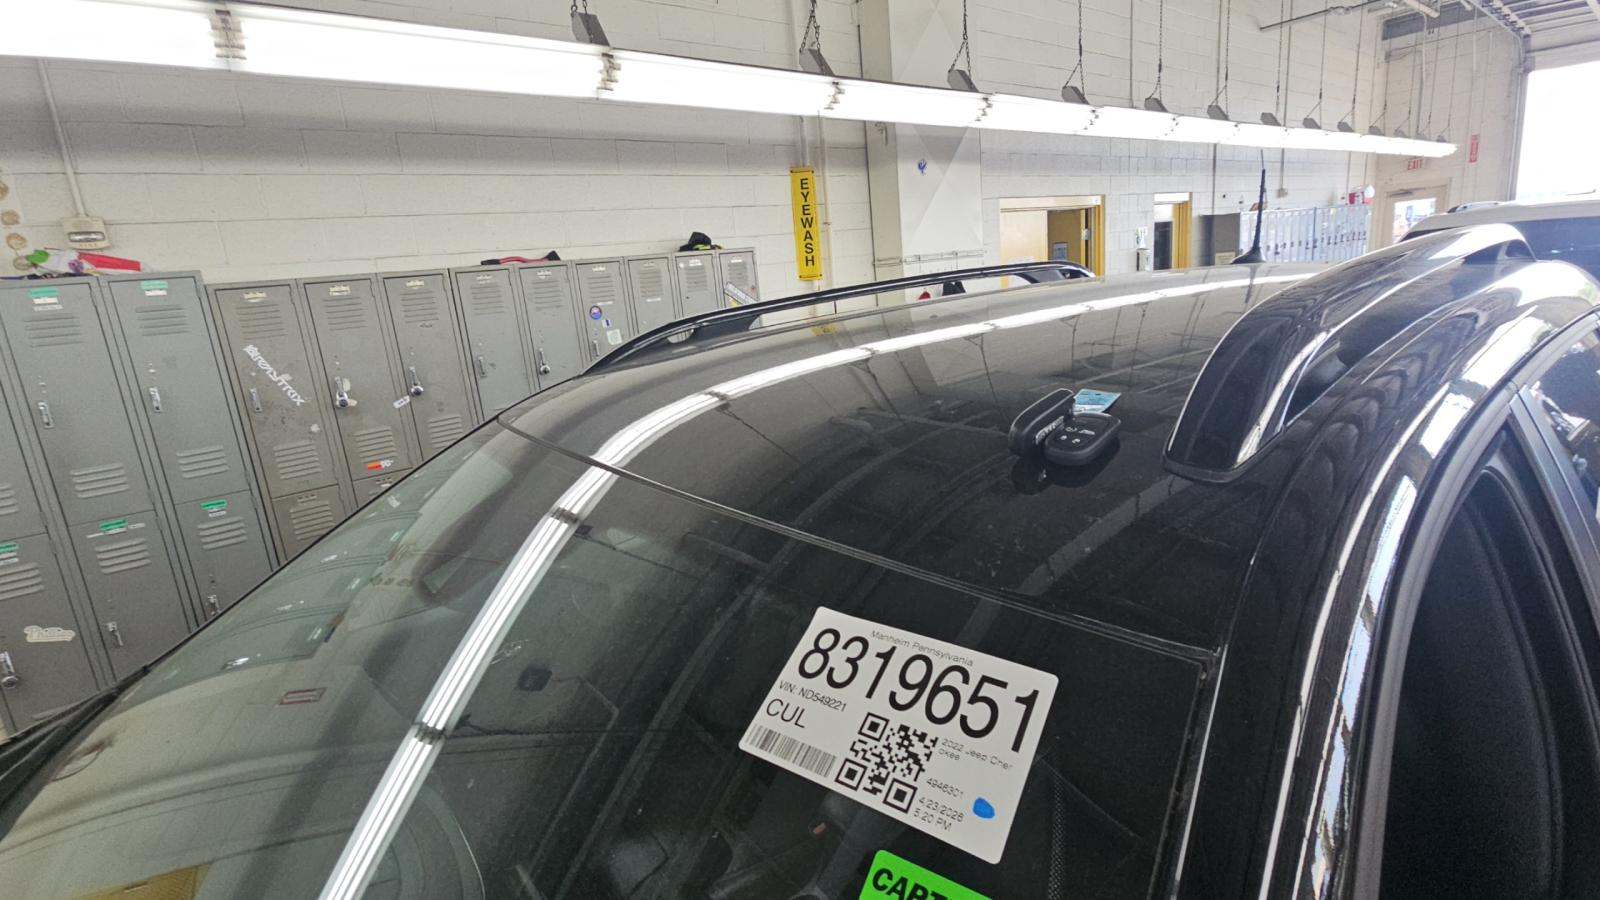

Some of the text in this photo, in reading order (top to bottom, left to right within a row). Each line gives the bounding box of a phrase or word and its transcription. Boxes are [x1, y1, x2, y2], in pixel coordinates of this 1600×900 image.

[800, 178, 815, 267] EYEWASH
[871, 630, 974, 668] Manheim Pennsylvania
[780, 680, 847, 712] VIN: ND549221
[798, 628, 1040, 753] 8319651
[766, 698, 805, 728] CUL
